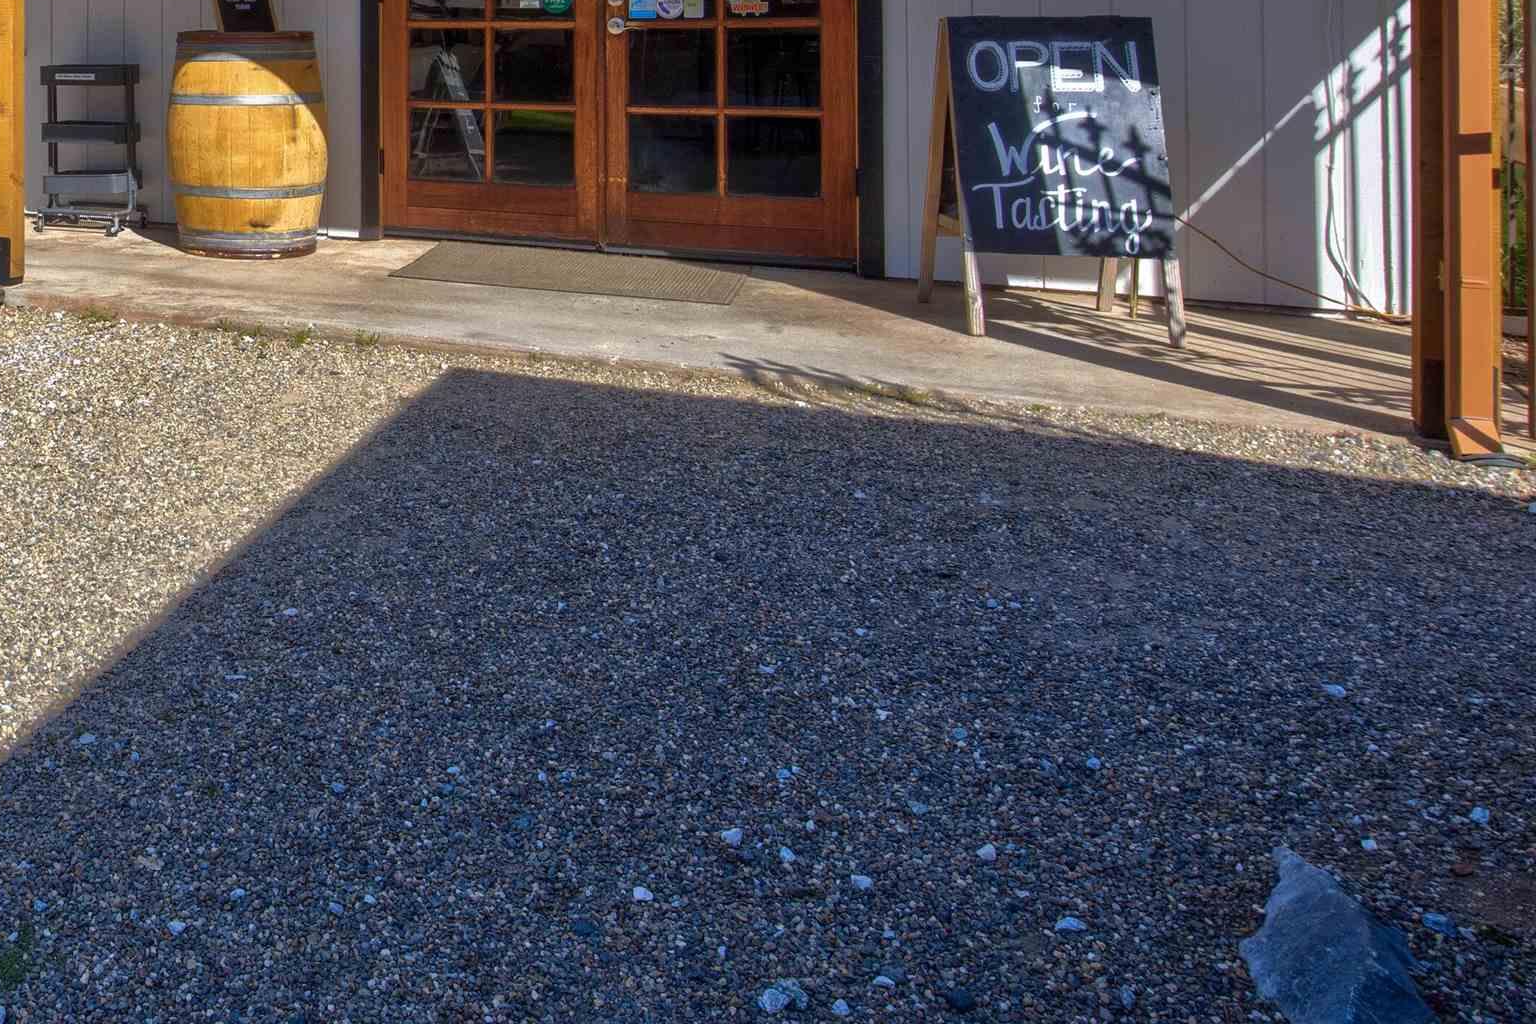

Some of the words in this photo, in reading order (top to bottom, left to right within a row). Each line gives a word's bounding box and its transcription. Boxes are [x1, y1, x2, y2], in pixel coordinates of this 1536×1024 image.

[967, 40, 1142, 93] OPEN
[1033, 95, 1077, 113] for
[987, 110, 1140, 177] Wine
[972, 176, 1153, 254] Tasting
